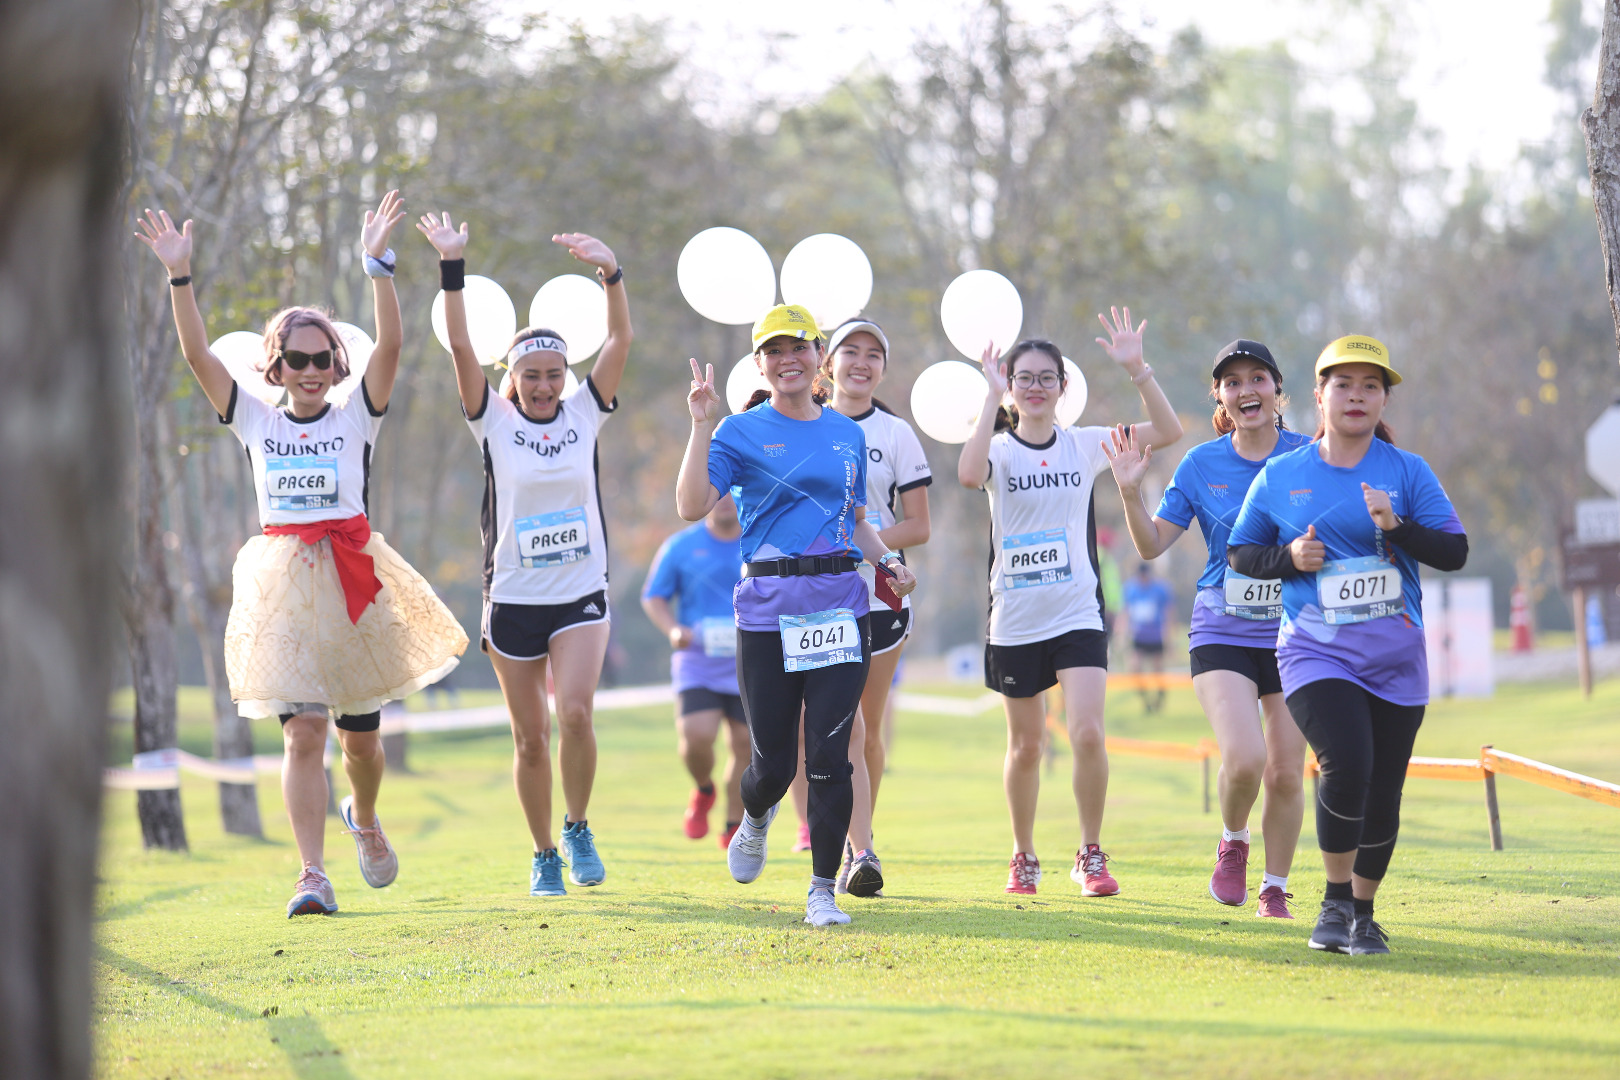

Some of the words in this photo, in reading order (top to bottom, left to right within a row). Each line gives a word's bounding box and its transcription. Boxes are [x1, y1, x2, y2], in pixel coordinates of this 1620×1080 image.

[524, 339, 559, 352] FILA
[1346, 342, 1382, 356] SEIKO
[264, 437, 343, 456] SUUNTO
[866, 446, 883, 463] O
[277, 474, 326, 490] PACER
[1008, 471, 1081, 493] SUUNTO
[531, 528, 578, 550] PACER
[1011, 548, 1058, 568] PACER
[1243, 583, 1282, 601] 6119
[1339, 574, 1387, 600] 6071
[799, 625, 845, 650] 6041
[845, 652, 855, 661] 16
